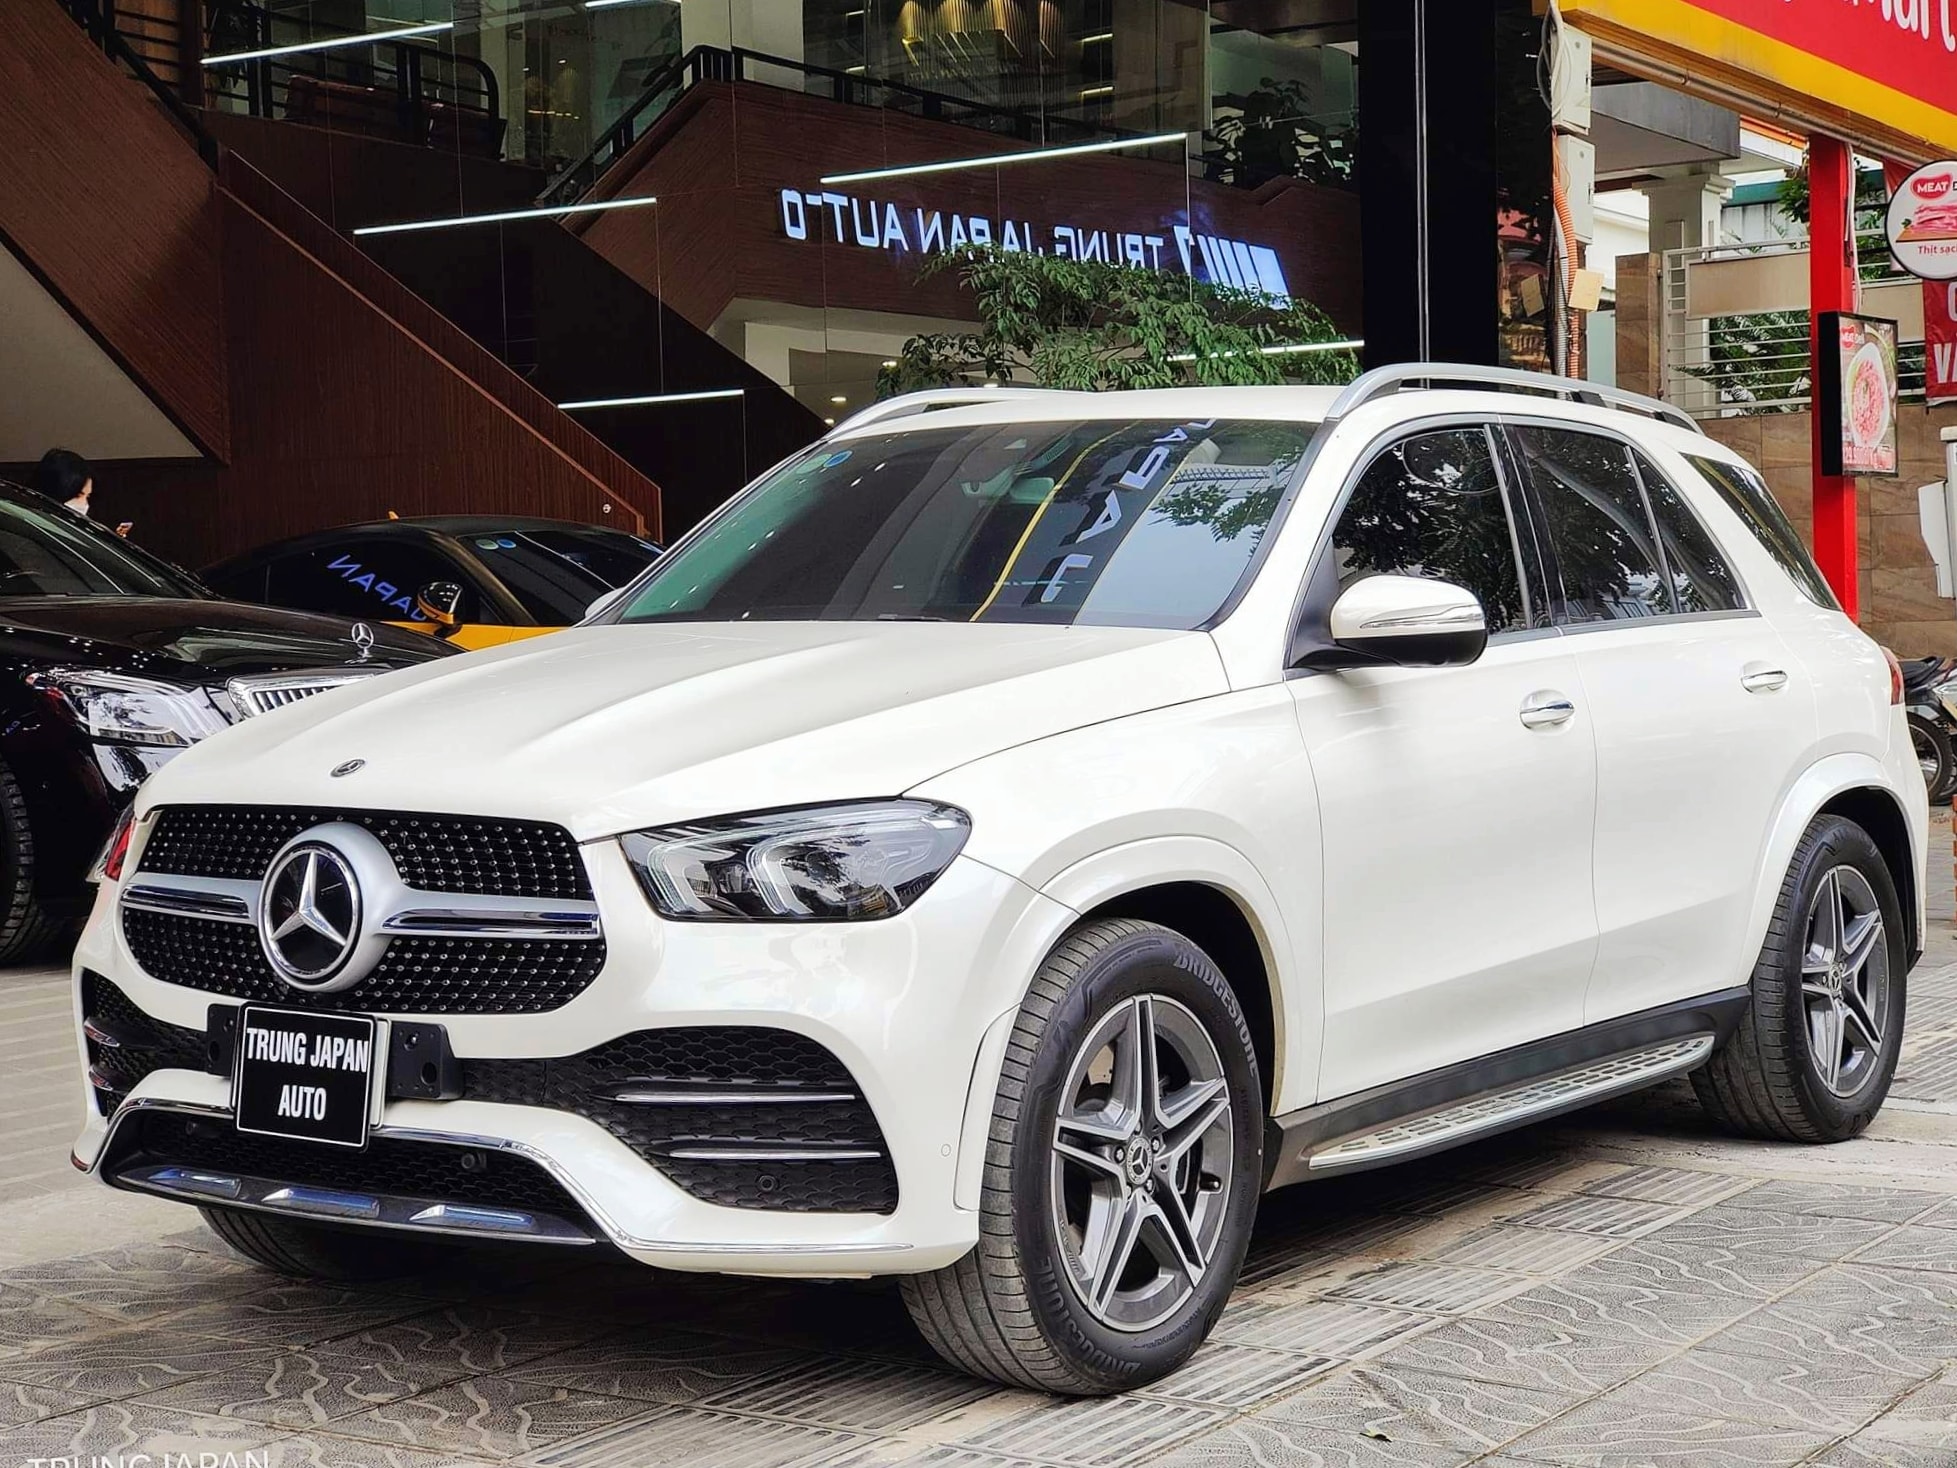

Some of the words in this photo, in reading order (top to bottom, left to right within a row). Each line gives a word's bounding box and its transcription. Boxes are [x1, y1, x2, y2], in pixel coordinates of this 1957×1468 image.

[1916, 181, 1949, 194] MEAT
[246, 1027, 307, 1066] TRUNG
[310, 1034, 370, 1074] JAPAN
[278, 1084, 328, 1121] AUTO
